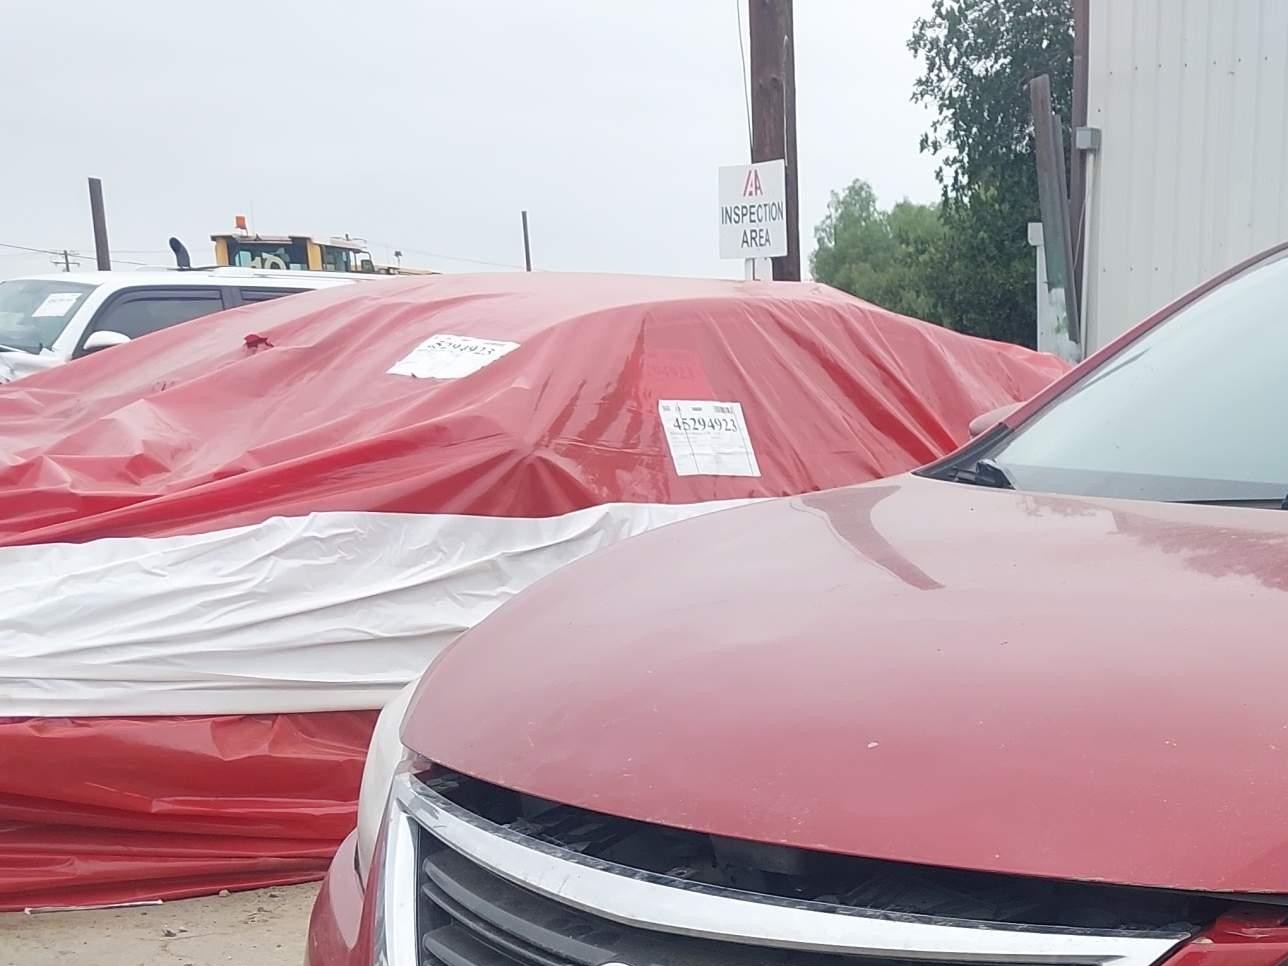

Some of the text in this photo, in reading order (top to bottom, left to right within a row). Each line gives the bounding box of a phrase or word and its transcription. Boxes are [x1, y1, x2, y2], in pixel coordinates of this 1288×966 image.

[721, 202, 784, 224] INSPECTION
[741, 228, 771, 248] AREA
[673, 417, 737, 433] 45294923
